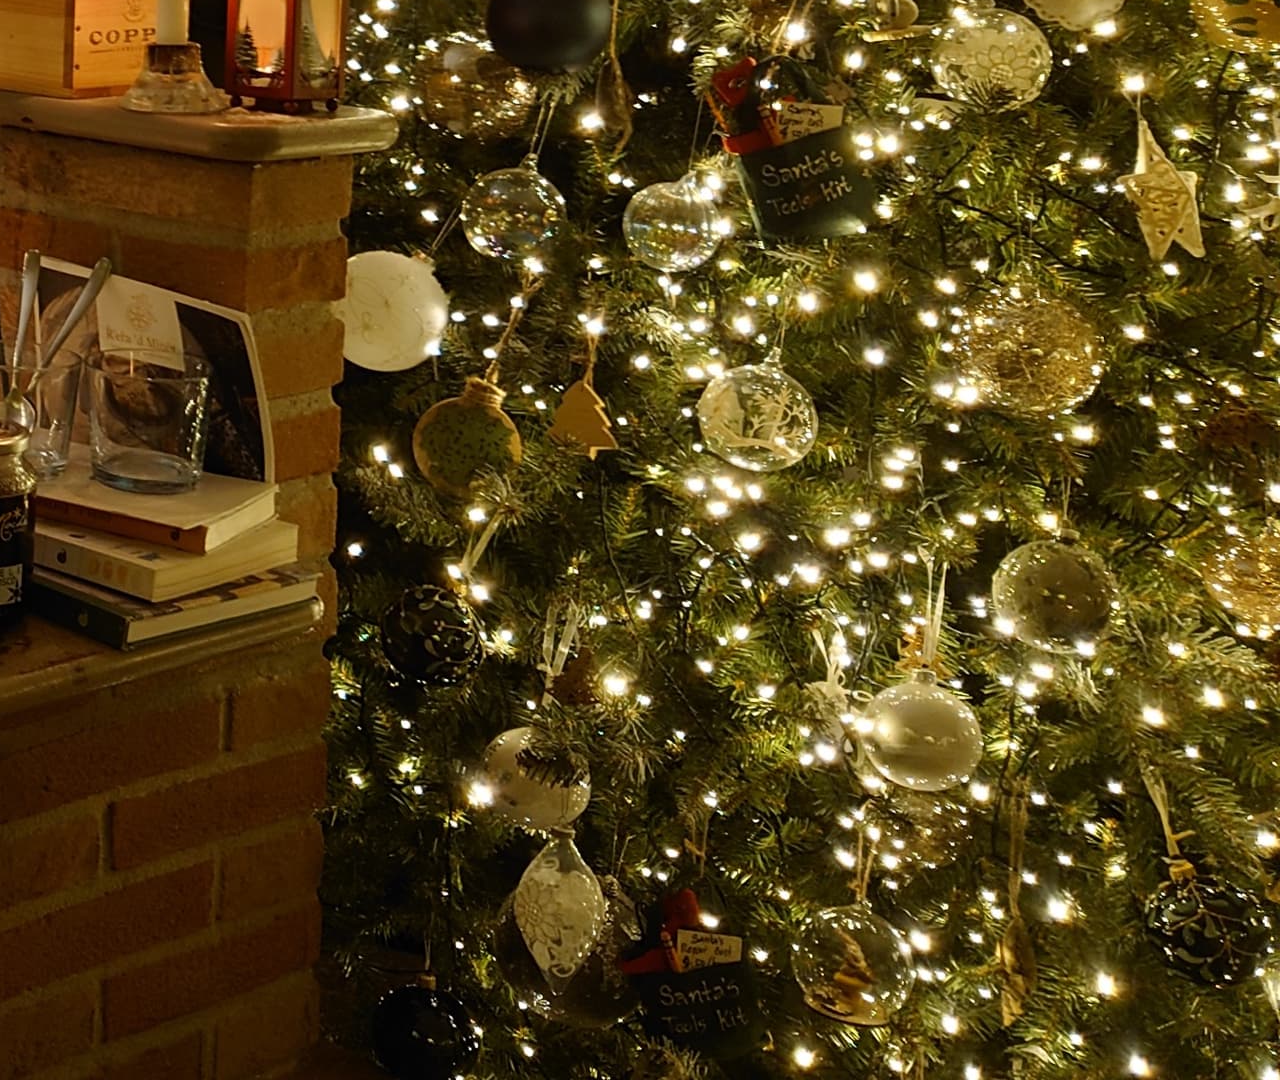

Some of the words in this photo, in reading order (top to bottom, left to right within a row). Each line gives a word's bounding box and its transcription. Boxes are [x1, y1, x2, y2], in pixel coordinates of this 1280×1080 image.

[89, 27, 157, 46] COPP
[760, 148, 845, 188] Santa's
[819, 175, 854, 203] Kit
[657, 976, 740, 1007] Santa's
[660, 1014, 707, 1034] Tools
[715, 1007, 750, 1032] Kit
